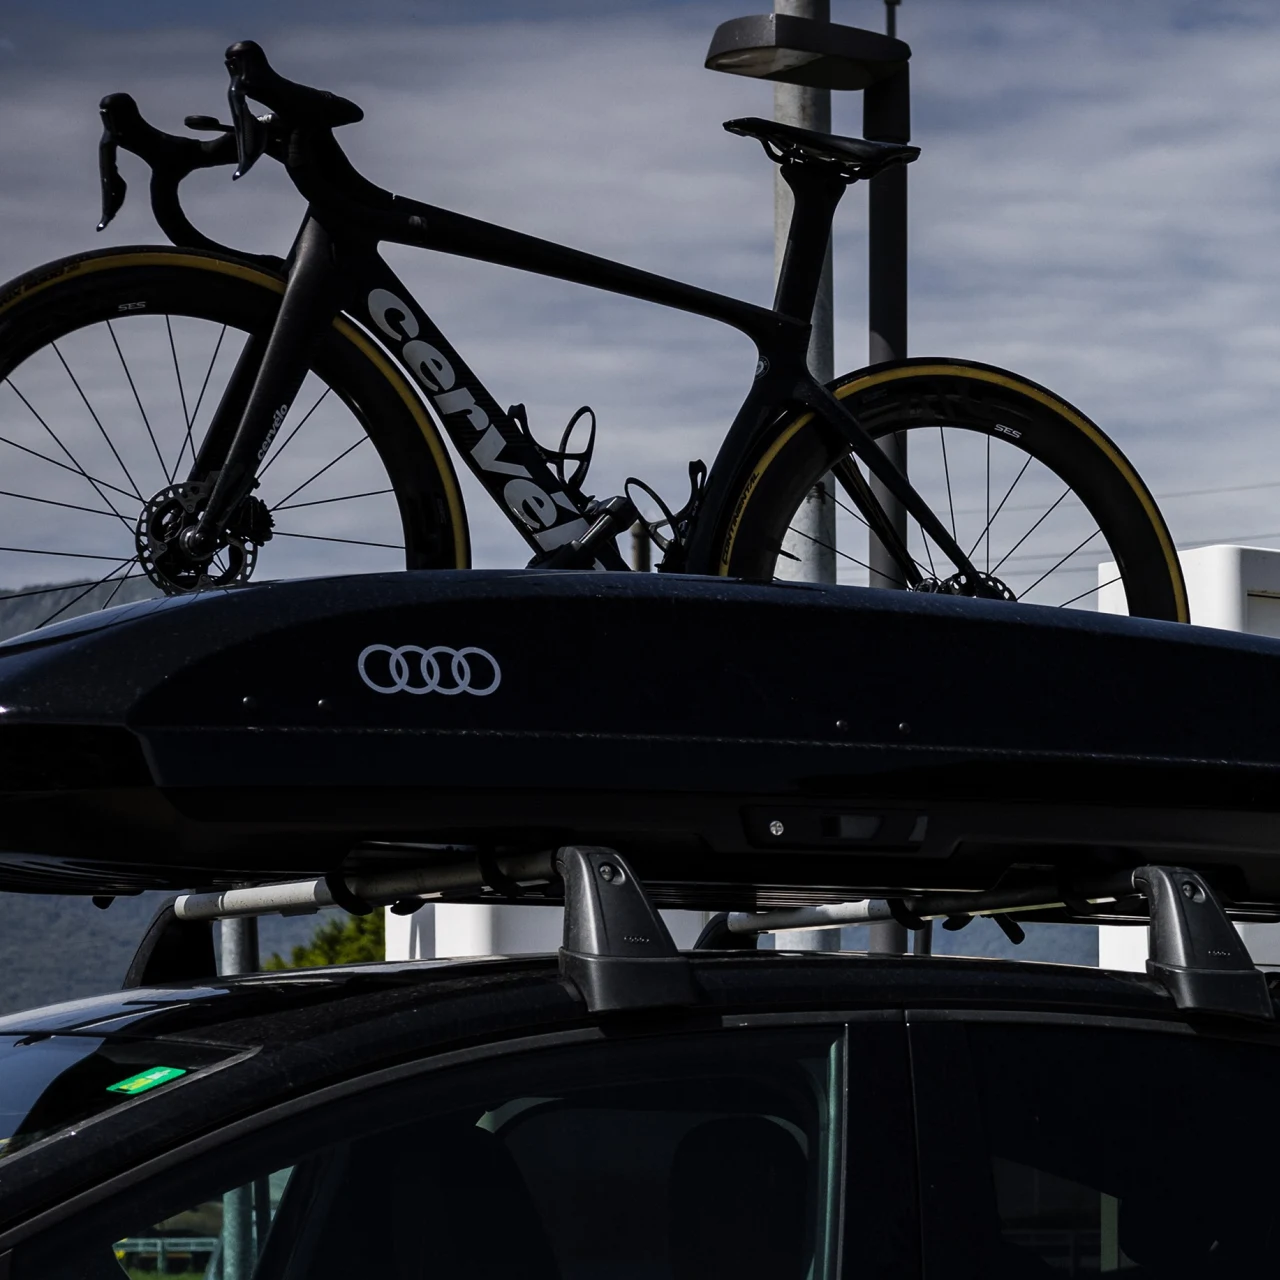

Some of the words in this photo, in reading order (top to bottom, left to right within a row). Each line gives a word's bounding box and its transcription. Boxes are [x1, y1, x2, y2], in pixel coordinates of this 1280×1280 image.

[117, 300, 148, 313] SES
[368, 288, 604, 569] cervél
[993, 423, 1023, 439] SES
[721, 471, 761, 566] CONTINENTAL
